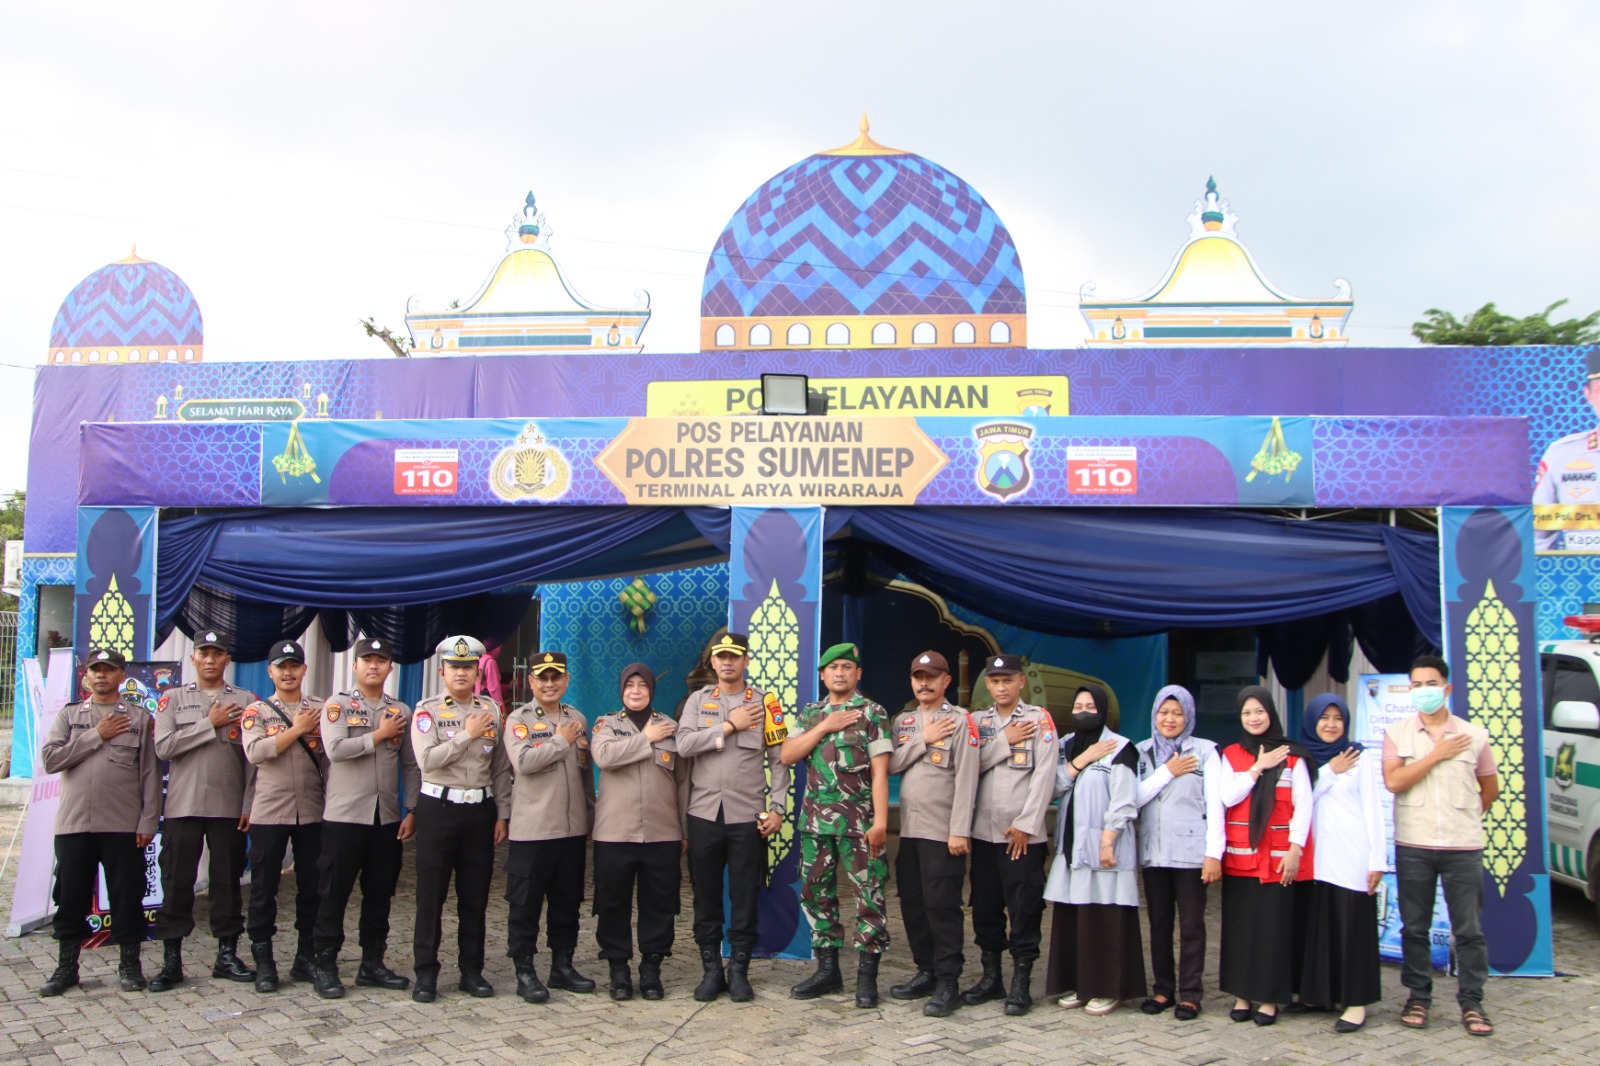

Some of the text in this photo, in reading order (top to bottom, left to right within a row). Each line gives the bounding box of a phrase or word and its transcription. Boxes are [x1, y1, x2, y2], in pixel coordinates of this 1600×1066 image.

[726, 384, 989, 412] PO ELAYANAN
[189, 405, 293, 417] SELAMAT HARI RAYA
[677, 421, 863, 443] POS PELAYANAN
[979, 426, 1029, 437] JAWA TIMUR
[625, 447, 914, 479] POLRES SUMENEP
[401, 470, 453, 488] 110
[1075, 468, 1132, 487] 110
[635, 483, 904, 498] TERMINAL ARYA WIRARAJA
[346, 709, 367, 717] IVAN
[438, 720, 461, 728] RIZKY
